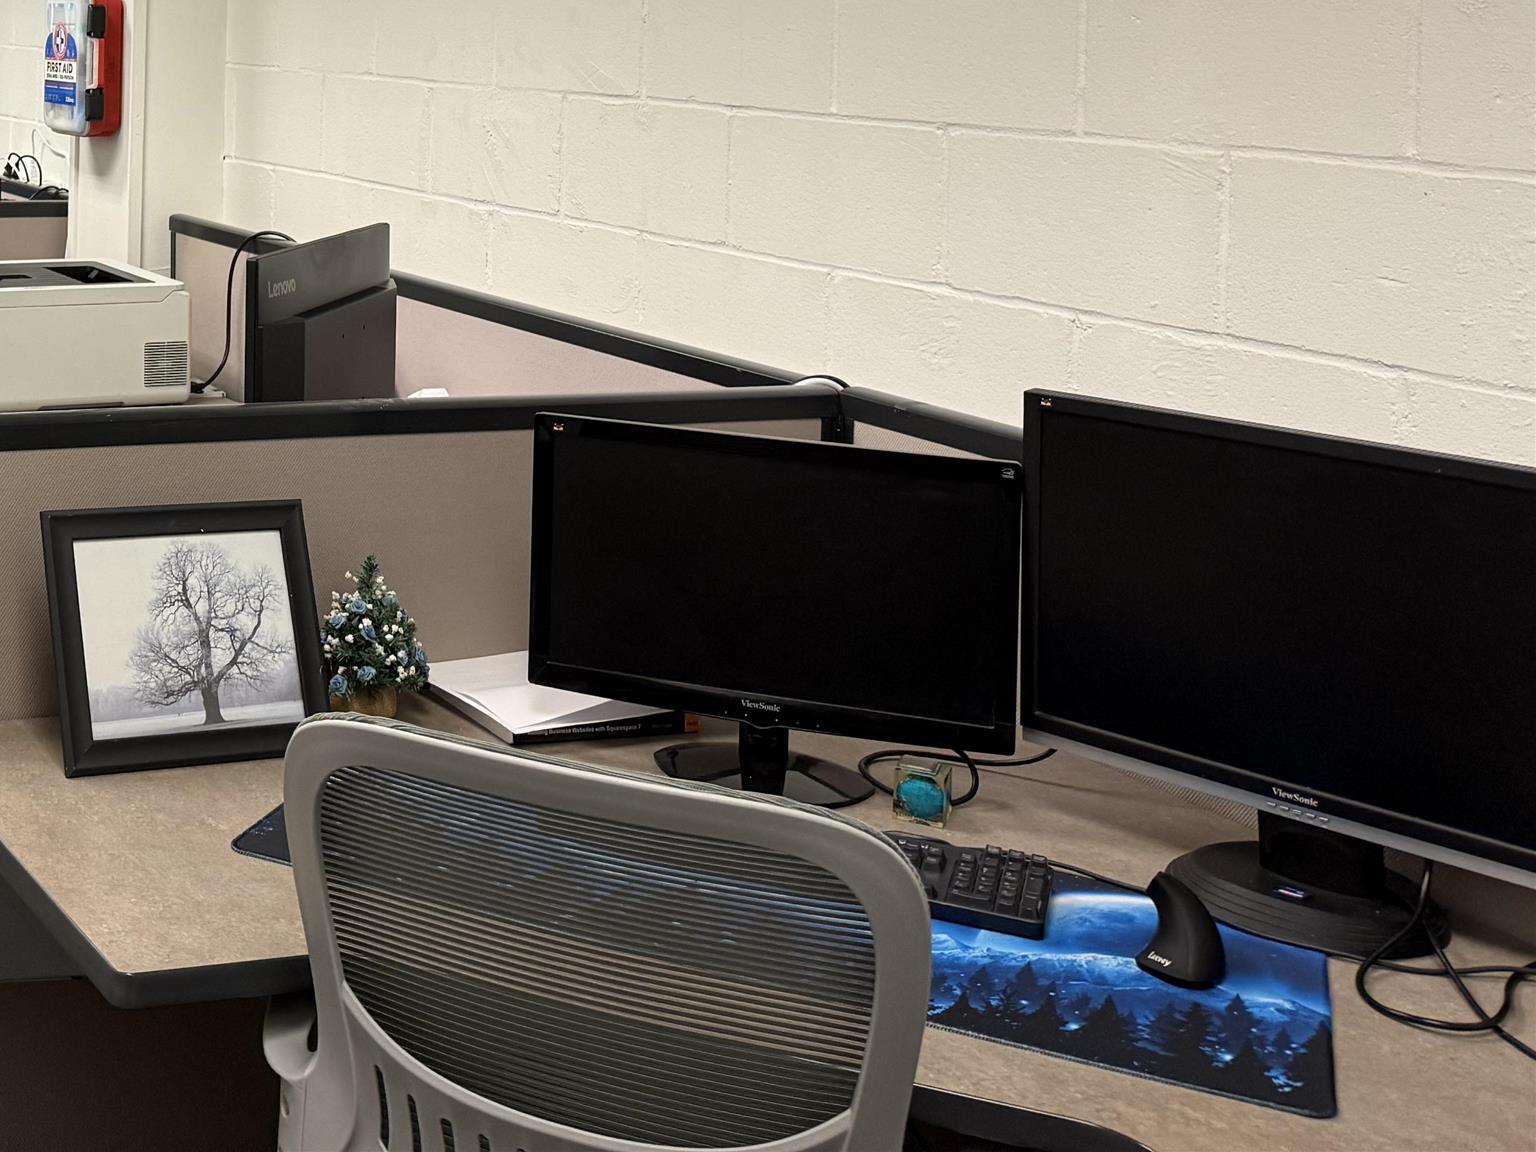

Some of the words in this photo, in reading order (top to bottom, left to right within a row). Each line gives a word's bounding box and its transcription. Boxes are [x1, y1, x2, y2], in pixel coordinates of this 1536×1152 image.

[47, 61, 62, 73] FIRST
[62, 63, 73, 74] AID
[267, 278, 296, 298] Lenovo
[741, 699, 781, 712] ViewSonic
[1272, 787, 1319, 807] ViewSonic
